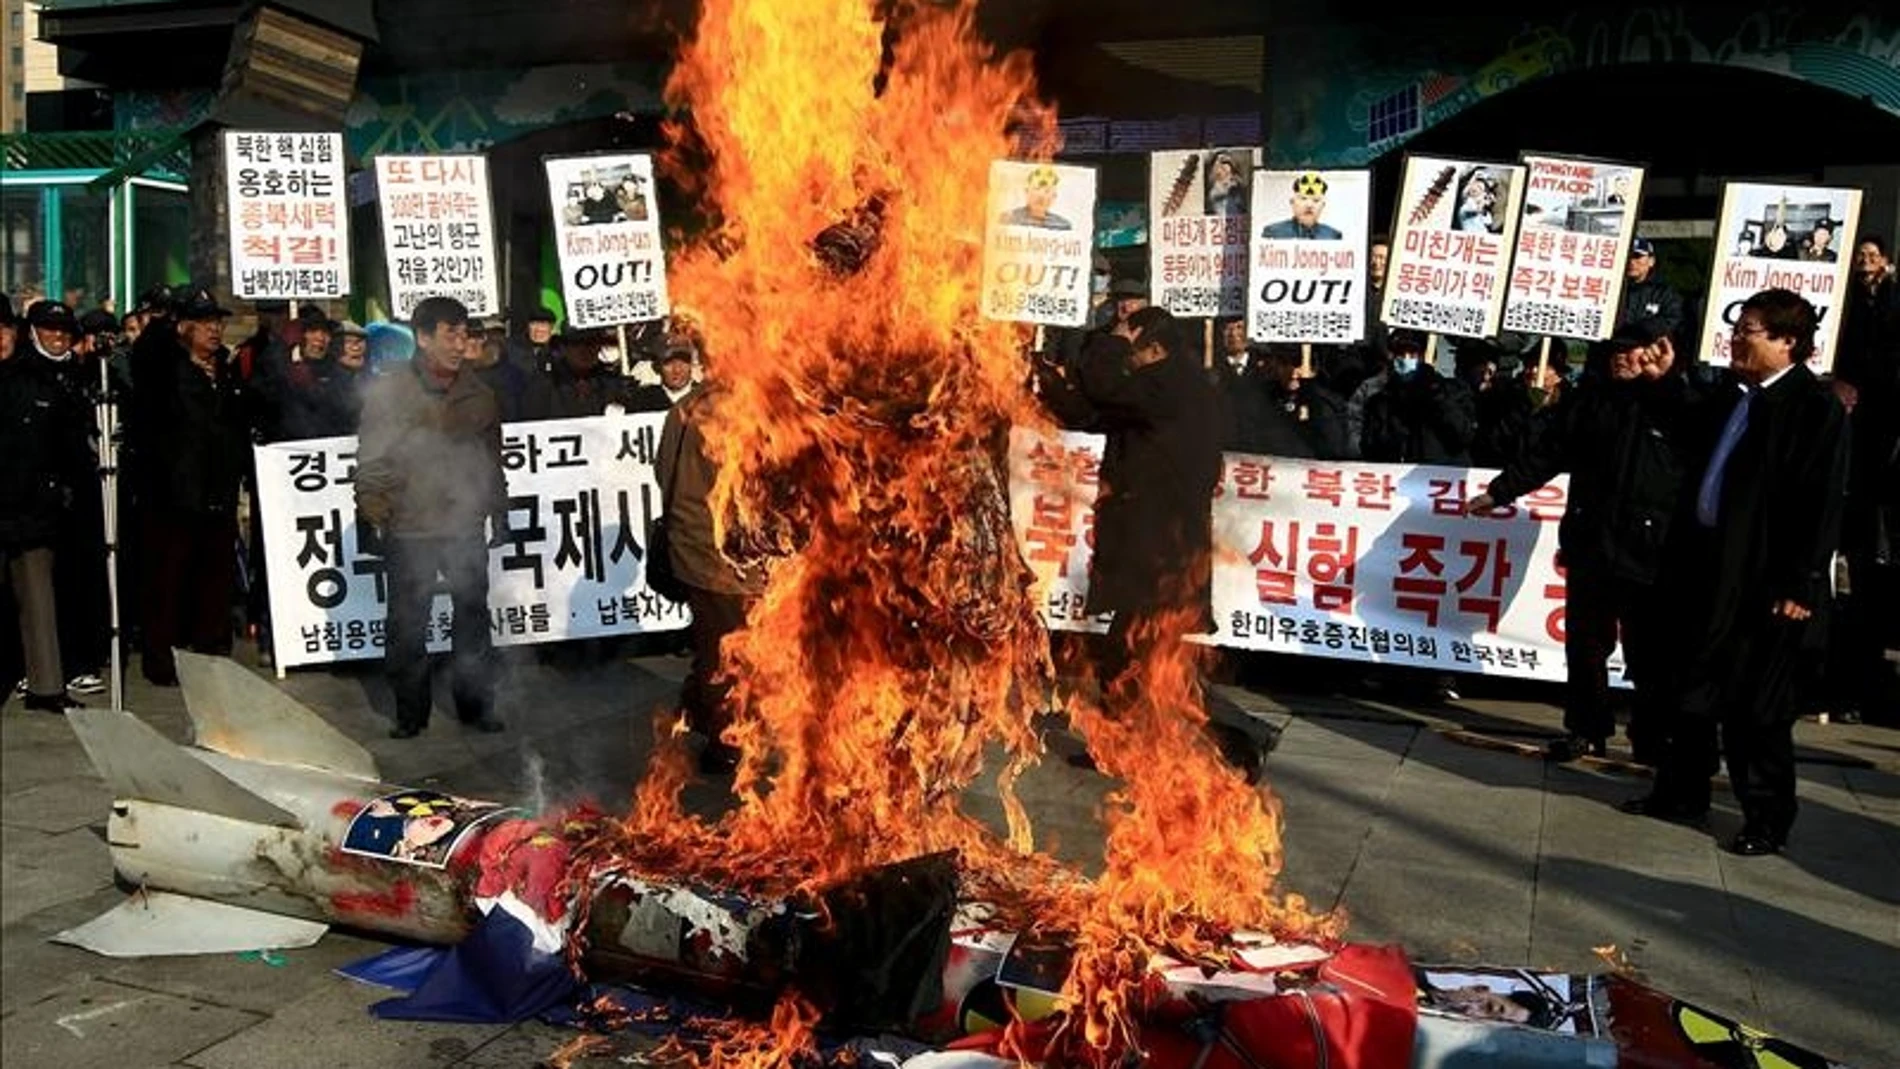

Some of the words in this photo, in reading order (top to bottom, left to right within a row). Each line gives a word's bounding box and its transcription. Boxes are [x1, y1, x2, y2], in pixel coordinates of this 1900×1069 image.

[236, 135, 272, 163] 북한
[276, 135, 294, 163] 핵
[299, 134, 333, 164] 실험
[238, 168, 333, 198] 옹호하는
[386, 160, 415, 184] 또
[420, 158, 476, 186] 다시
[240, 201, 336, 230] 종북세력
[393, 222, 444, 250] 고난의
[447, 221, 481, 250] 행군
[1163, 217, 1208, 247] 미친개
[1257, 243, 1288, 269] Kim
[1291, 245, 1355, 277] Jong-un
[1404, 229, 1499, 267] 미친개는
[1519, 230, 1556, 262] 북한
[1560, 234, 1578, 265] 핵
[1581, 238, 1619, 270] 실험
[241, 269, 339, 296] 납북자가족모임
[397, 255, 428, 286] 겪을
[431, 255, 484, 285] 것인가?
[574, 259, 653, 291] OUT!
[996, 262, 1080, 291] OUT!
[1163, 253, 1212, 283] 몽둥이가
[1397, 262, 1469, 299] 몽둥이가
[1472, 271, 1495, 301] 약!
[1723, 261, 1758, 289] Kim
[1760, 263, 1834, 294] Jong-un
[1260, 279, 1353, 305] OUT!
[1513, 266, 1557, 300] 즉각
[1559, 274, 1611, 306] 보복!
[1302, 468, 1397, 511] 북한
[1246, 519, 1360, 616] 실험
[1392, 532, 1513, 635] 즉각
[1231, 609, 1439, 660] 한미우호증진협의회
[1450, 640, 1542, 671] 한국본부
